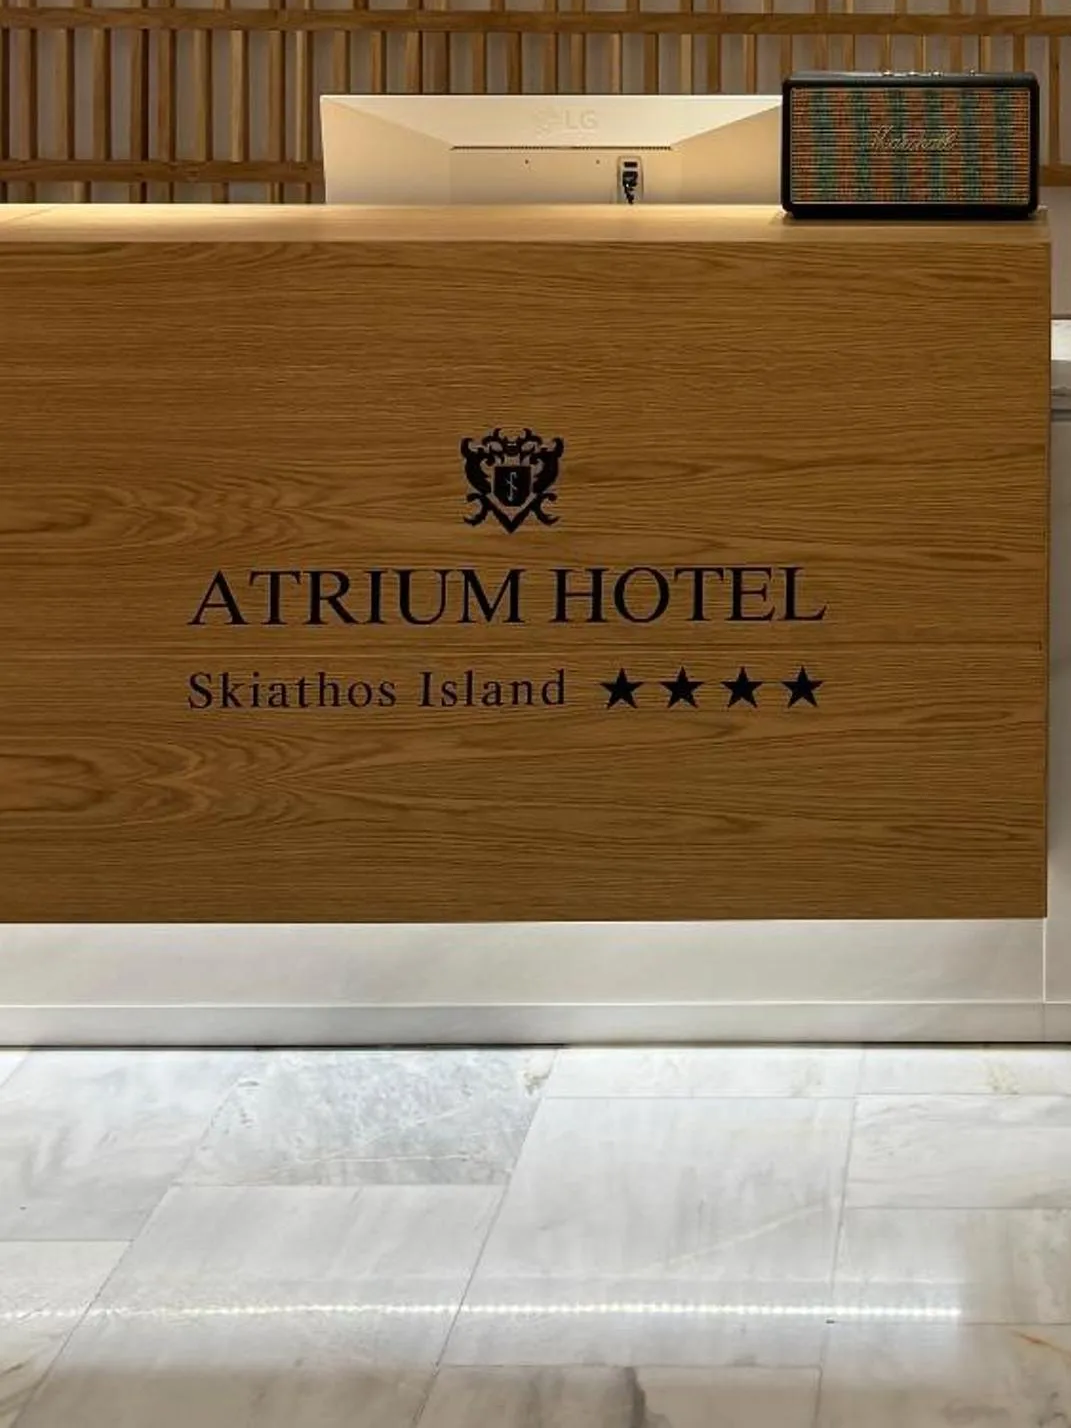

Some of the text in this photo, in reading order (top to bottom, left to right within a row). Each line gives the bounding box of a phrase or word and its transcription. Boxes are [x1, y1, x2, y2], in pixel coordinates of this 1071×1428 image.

[564, 109, 598, 130] LG
[187, 566, 828, 626] ATRIUM HOTEL
[188, 669, 566, 709] Skiathos Island
